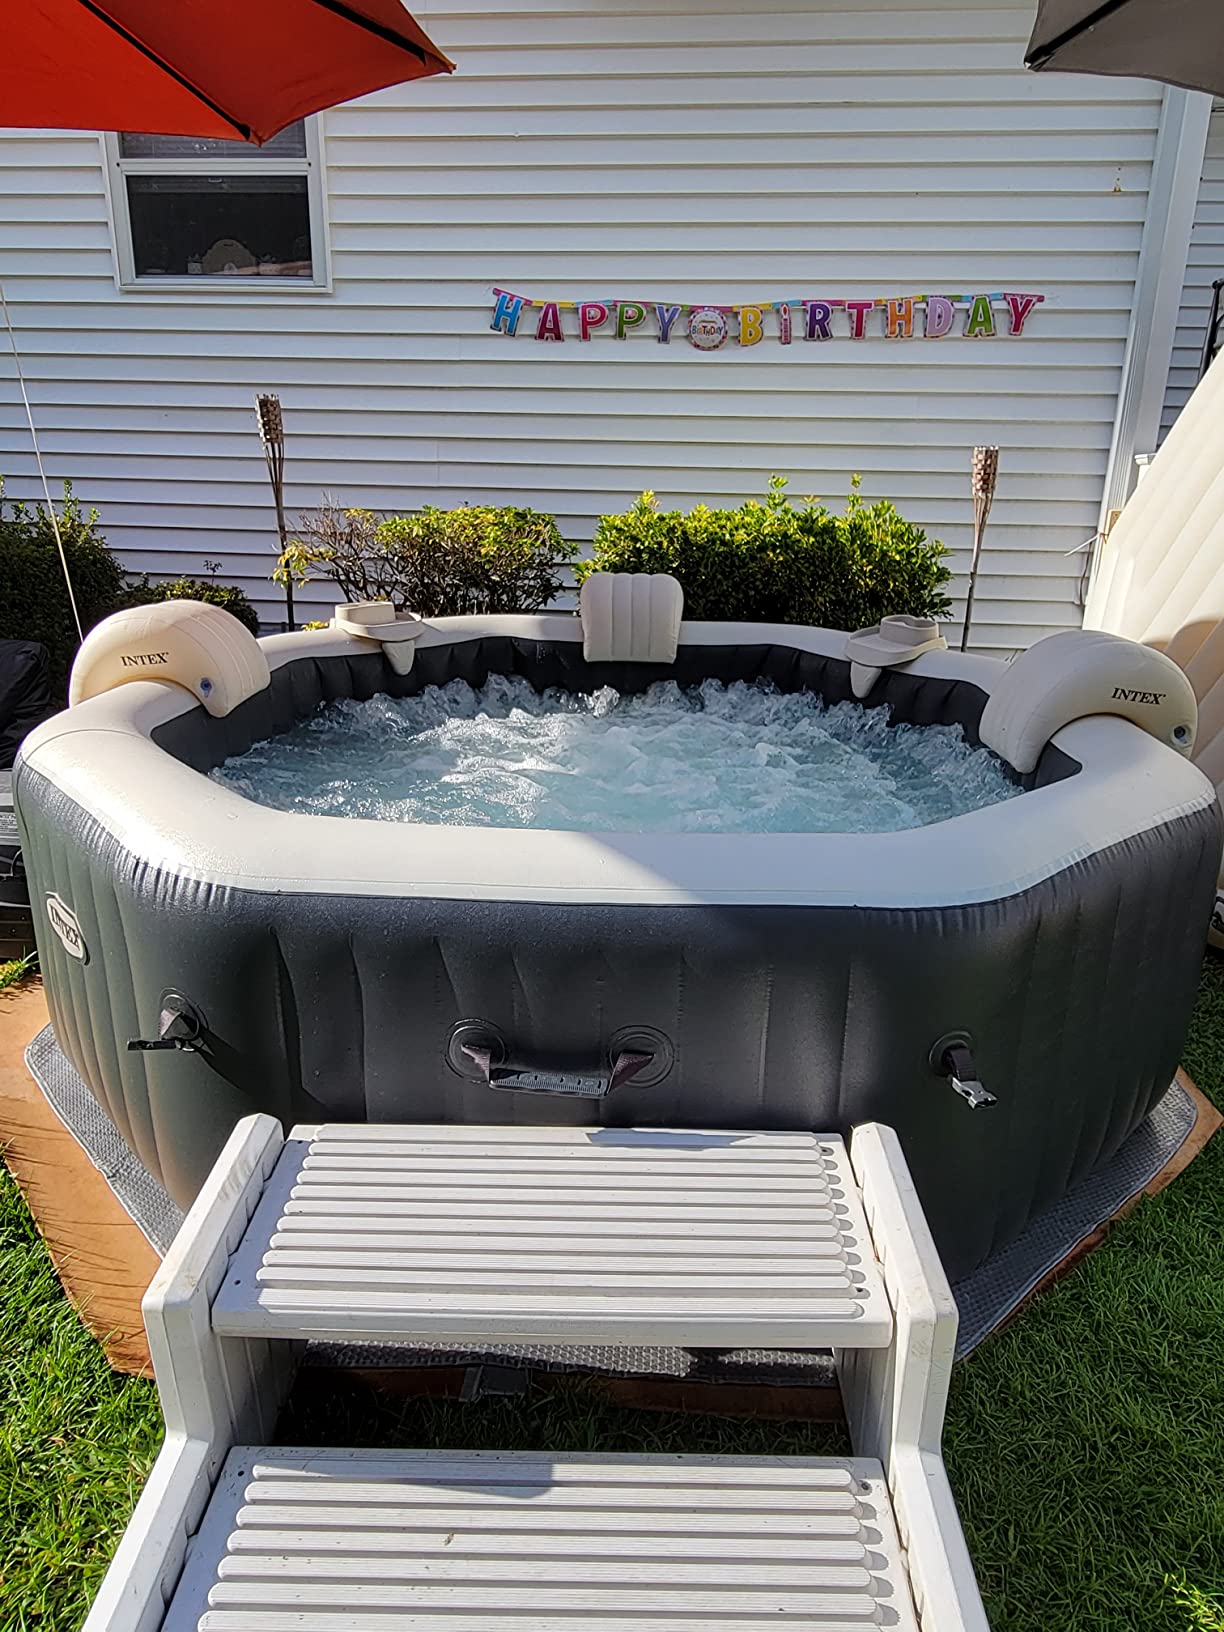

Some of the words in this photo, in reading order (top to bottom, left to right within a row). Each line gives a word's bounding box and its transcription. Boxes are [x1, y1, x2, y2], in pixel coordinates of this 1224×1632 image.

[490, 293, 682, 344] HAPPY
[738, 294, 1036, 345] BIRTHDAY
[121, 652, 168, 666] INTEX
[1111, 687, 1164, 705] INTEX
[49, 904, 80, 948] INTEX
